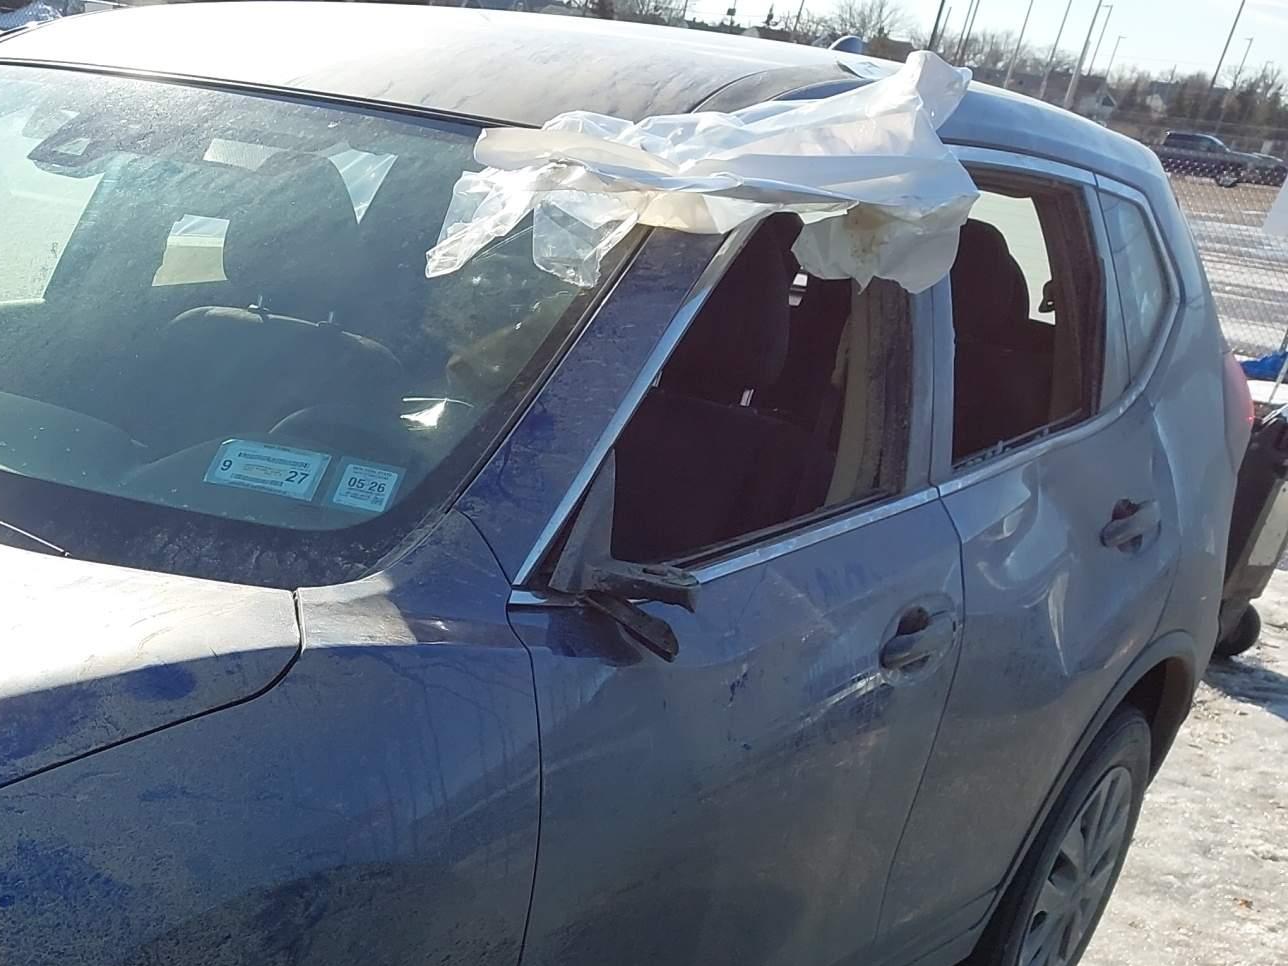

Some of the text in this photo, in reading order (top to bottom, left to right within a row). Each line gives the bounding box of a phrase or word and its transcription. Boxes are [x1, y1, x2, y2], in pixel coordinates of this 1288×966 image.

[220, 459, 233, 471] 9
[285, 470, 309, 485] 27
[348, 476, 386, 493] 05 26
